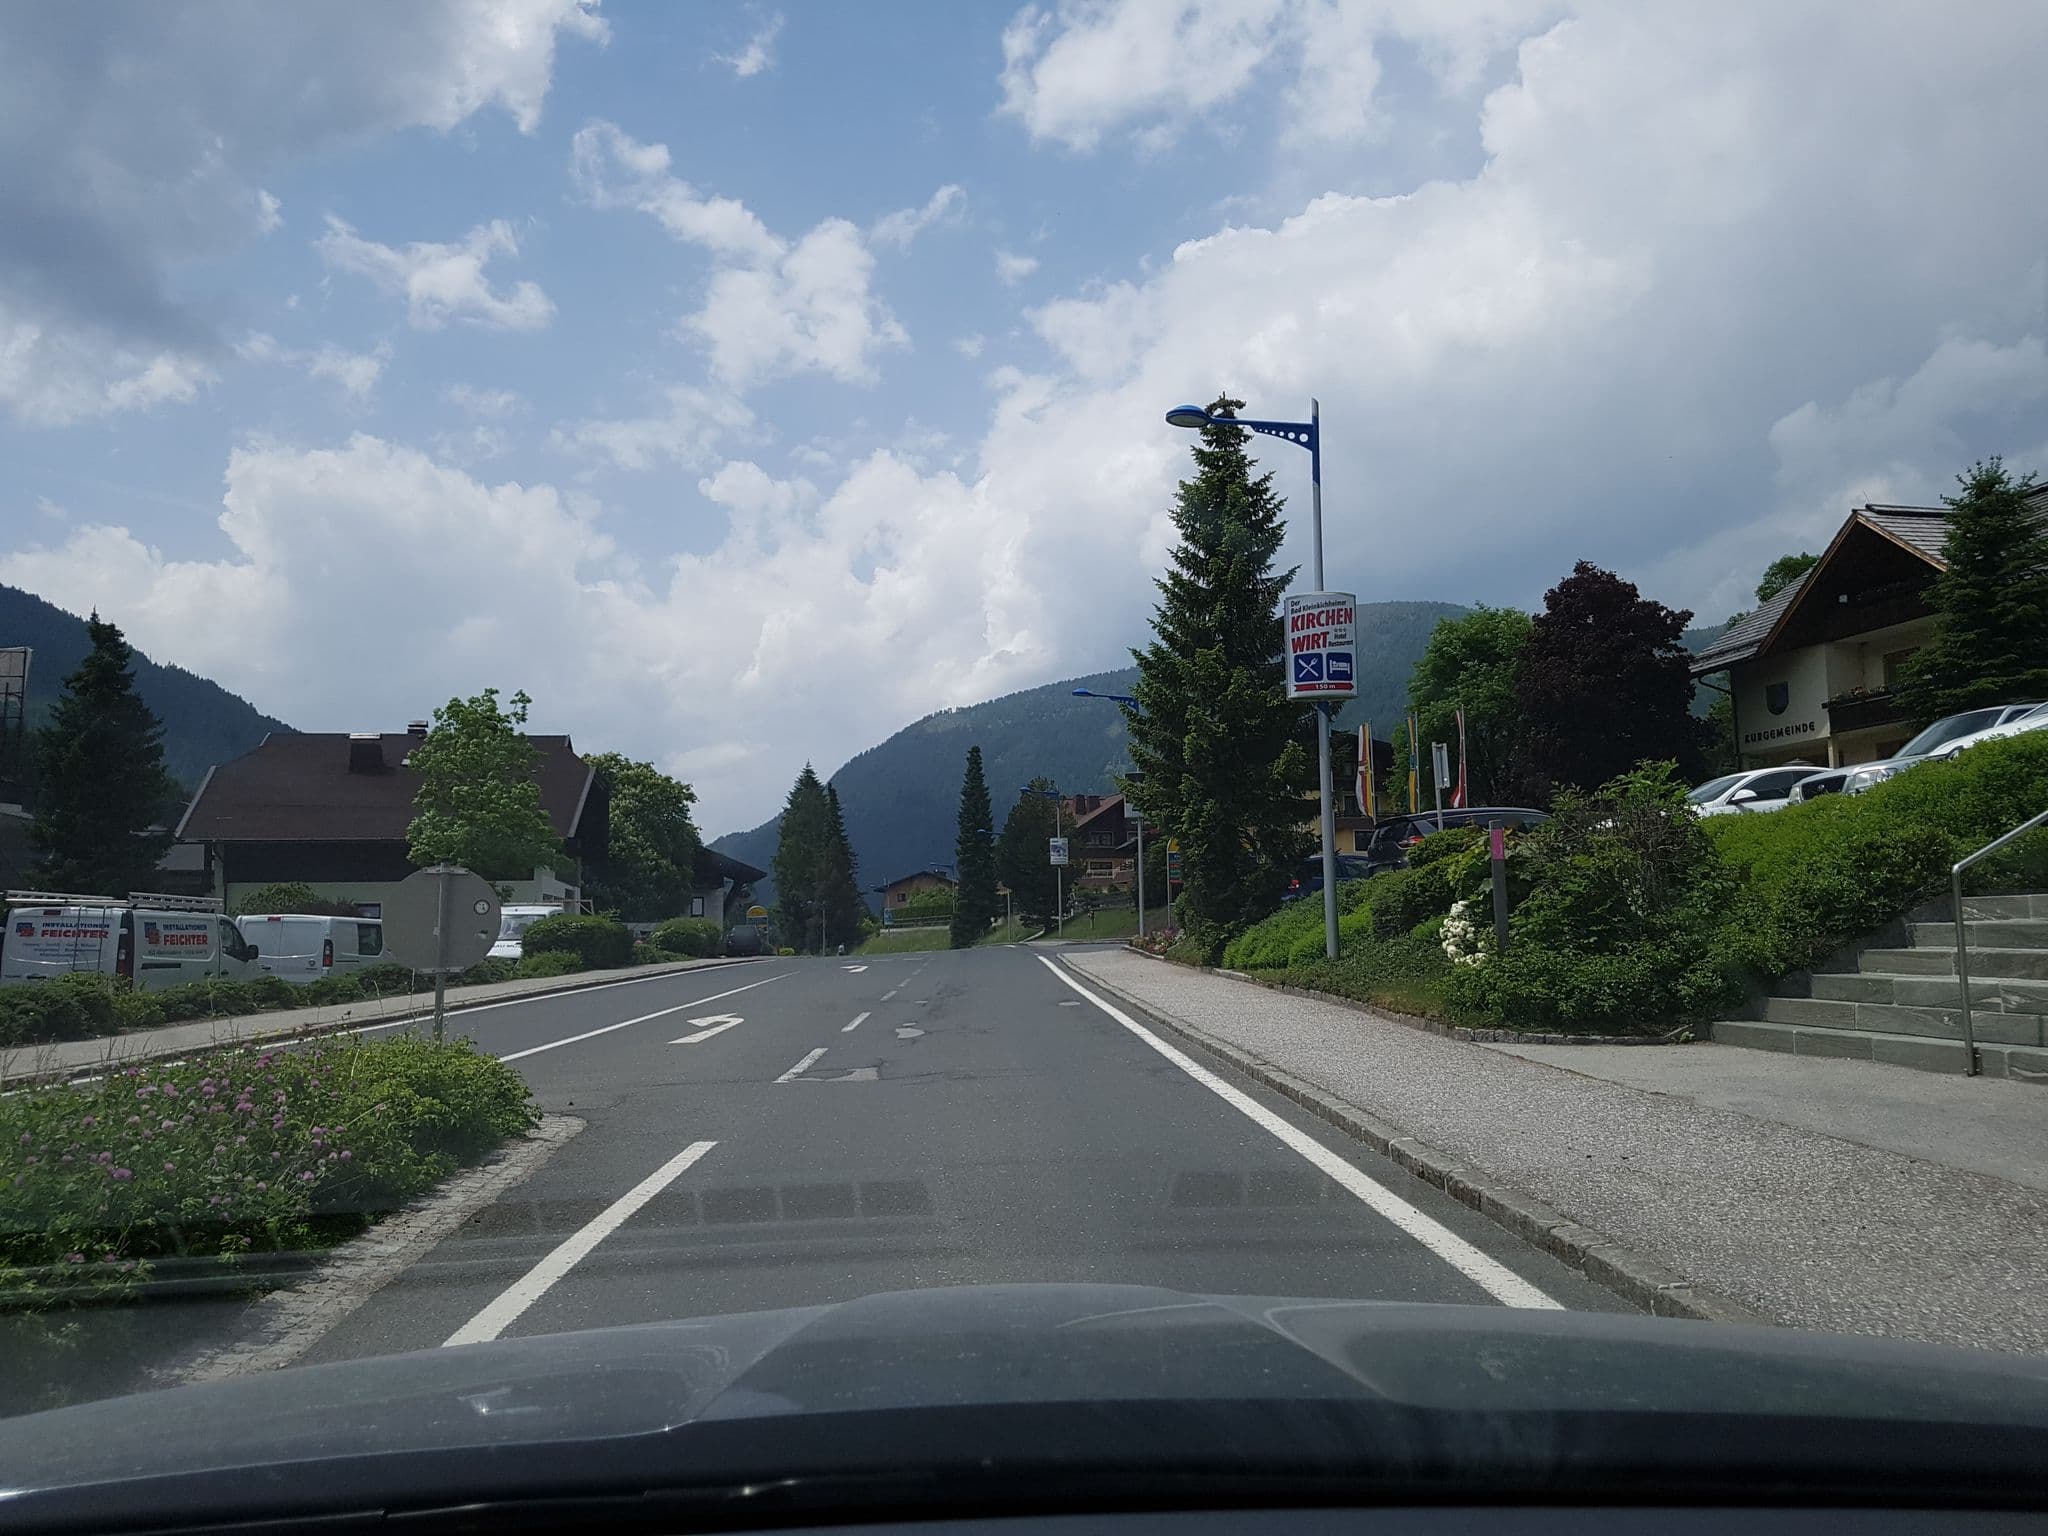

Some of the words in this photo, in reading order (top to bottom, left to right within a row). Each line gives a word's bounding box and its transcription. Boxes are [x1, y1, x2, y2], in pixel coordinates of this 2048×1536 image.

[1291, 607, 1353, 633] KIRCHEN
[1291, 631, 1330, 654] WIRT
[1744, 721, 1816, 744] KURGEMEINDE
[41, 929, 109, 939] FEICHTER
[163, 923, 208, 931] INSTALLATIONEN
[163, 934, 208, 946] FEICHTER
